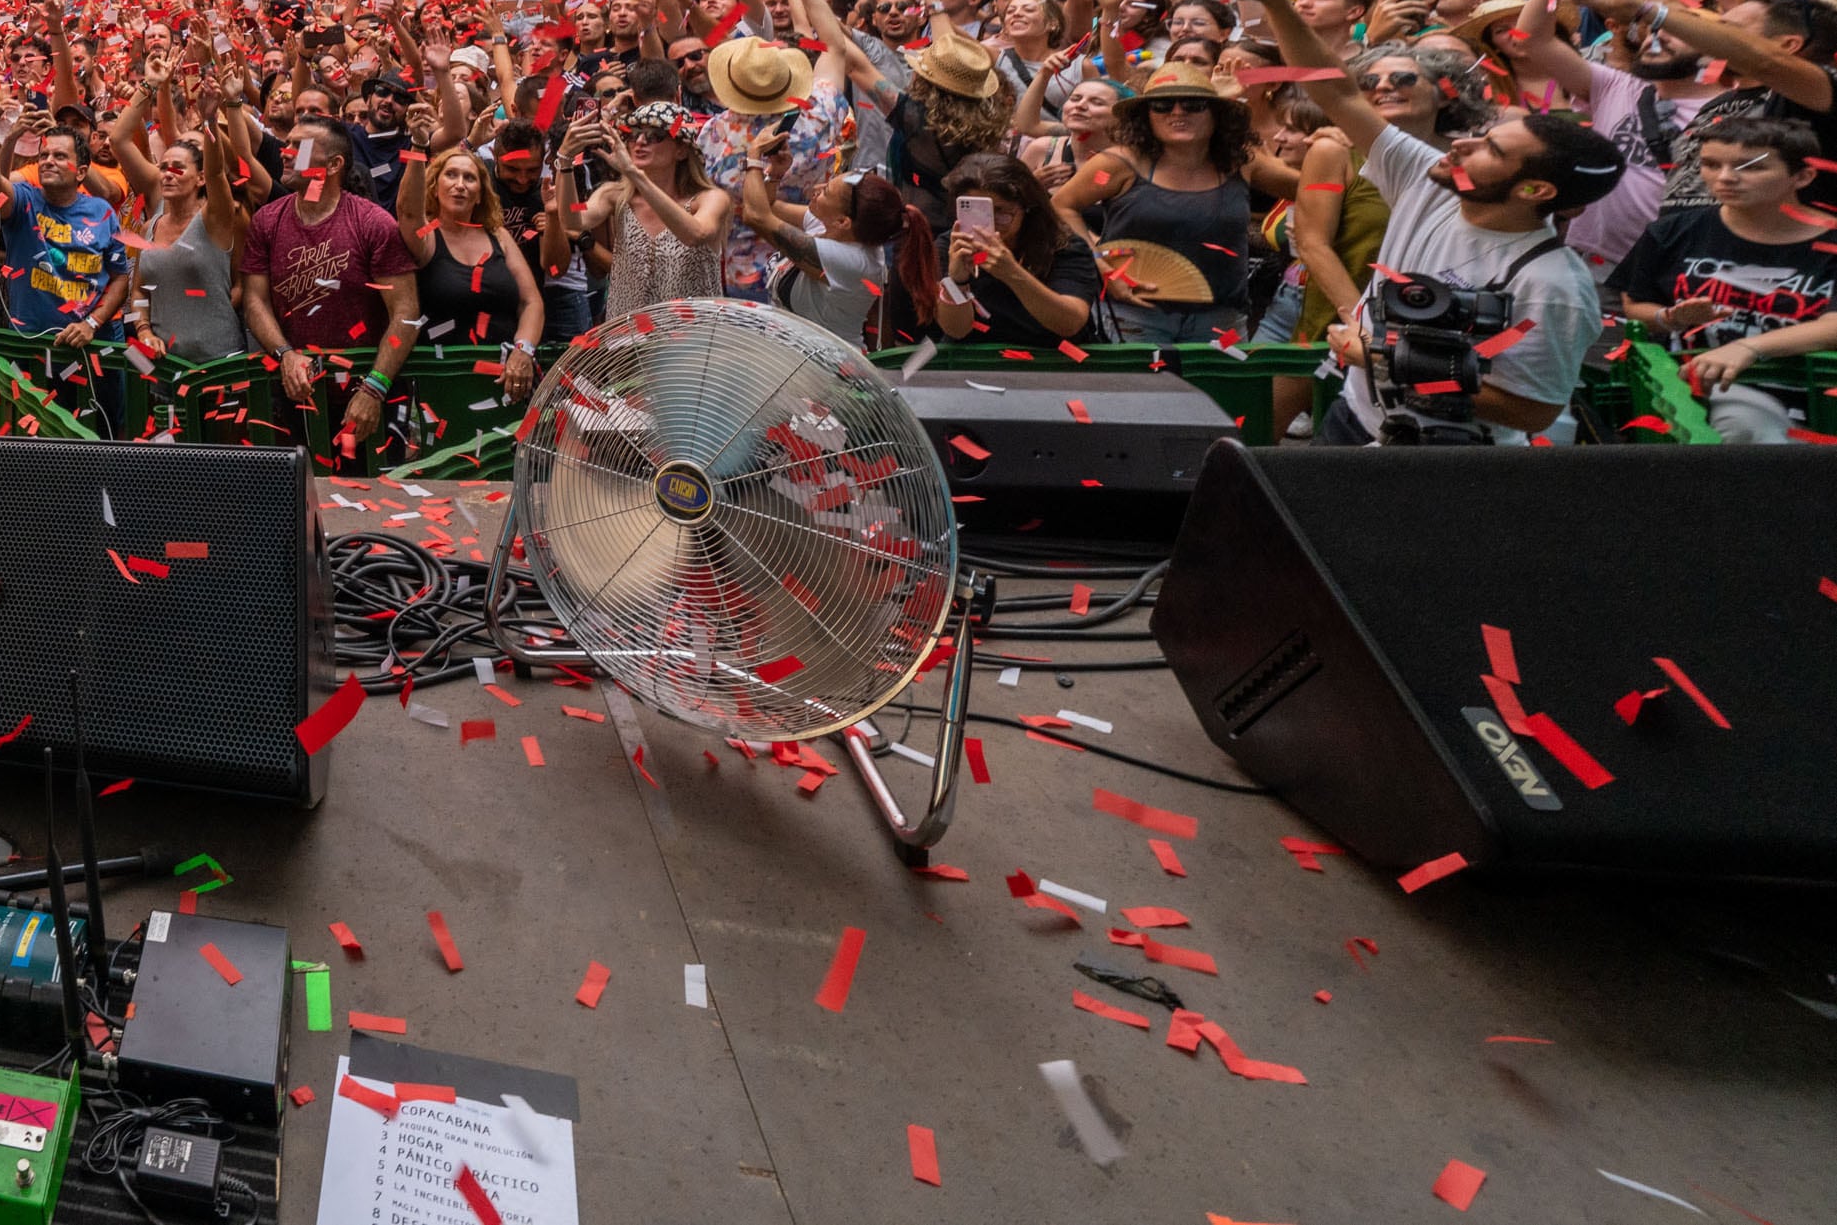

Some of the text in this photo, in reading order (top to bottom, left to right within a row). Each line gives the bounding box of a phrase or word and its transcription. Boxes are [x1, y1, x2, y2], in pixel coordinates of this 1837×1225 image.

[287, 238, 332, 271] ARDE
[400, 1104, 492, 1137] COPACABANA
[381, 1130, 445, 1155] 3 HOGAR
[444, 1132, 469, 1146] GRAN
[377, 1159, 386, 1171] 5
[379, 1145, 540, 1194] 4 PÁNICO RÁCTICO
[375, 1175, 384, 1187] 6
[393, 1181, 407, 1193] LA
[371, 1207, 381, 1220] 8
[374, 1191, 383, 1202] 7
[392, 1199, 420, 1214] MAGIA
